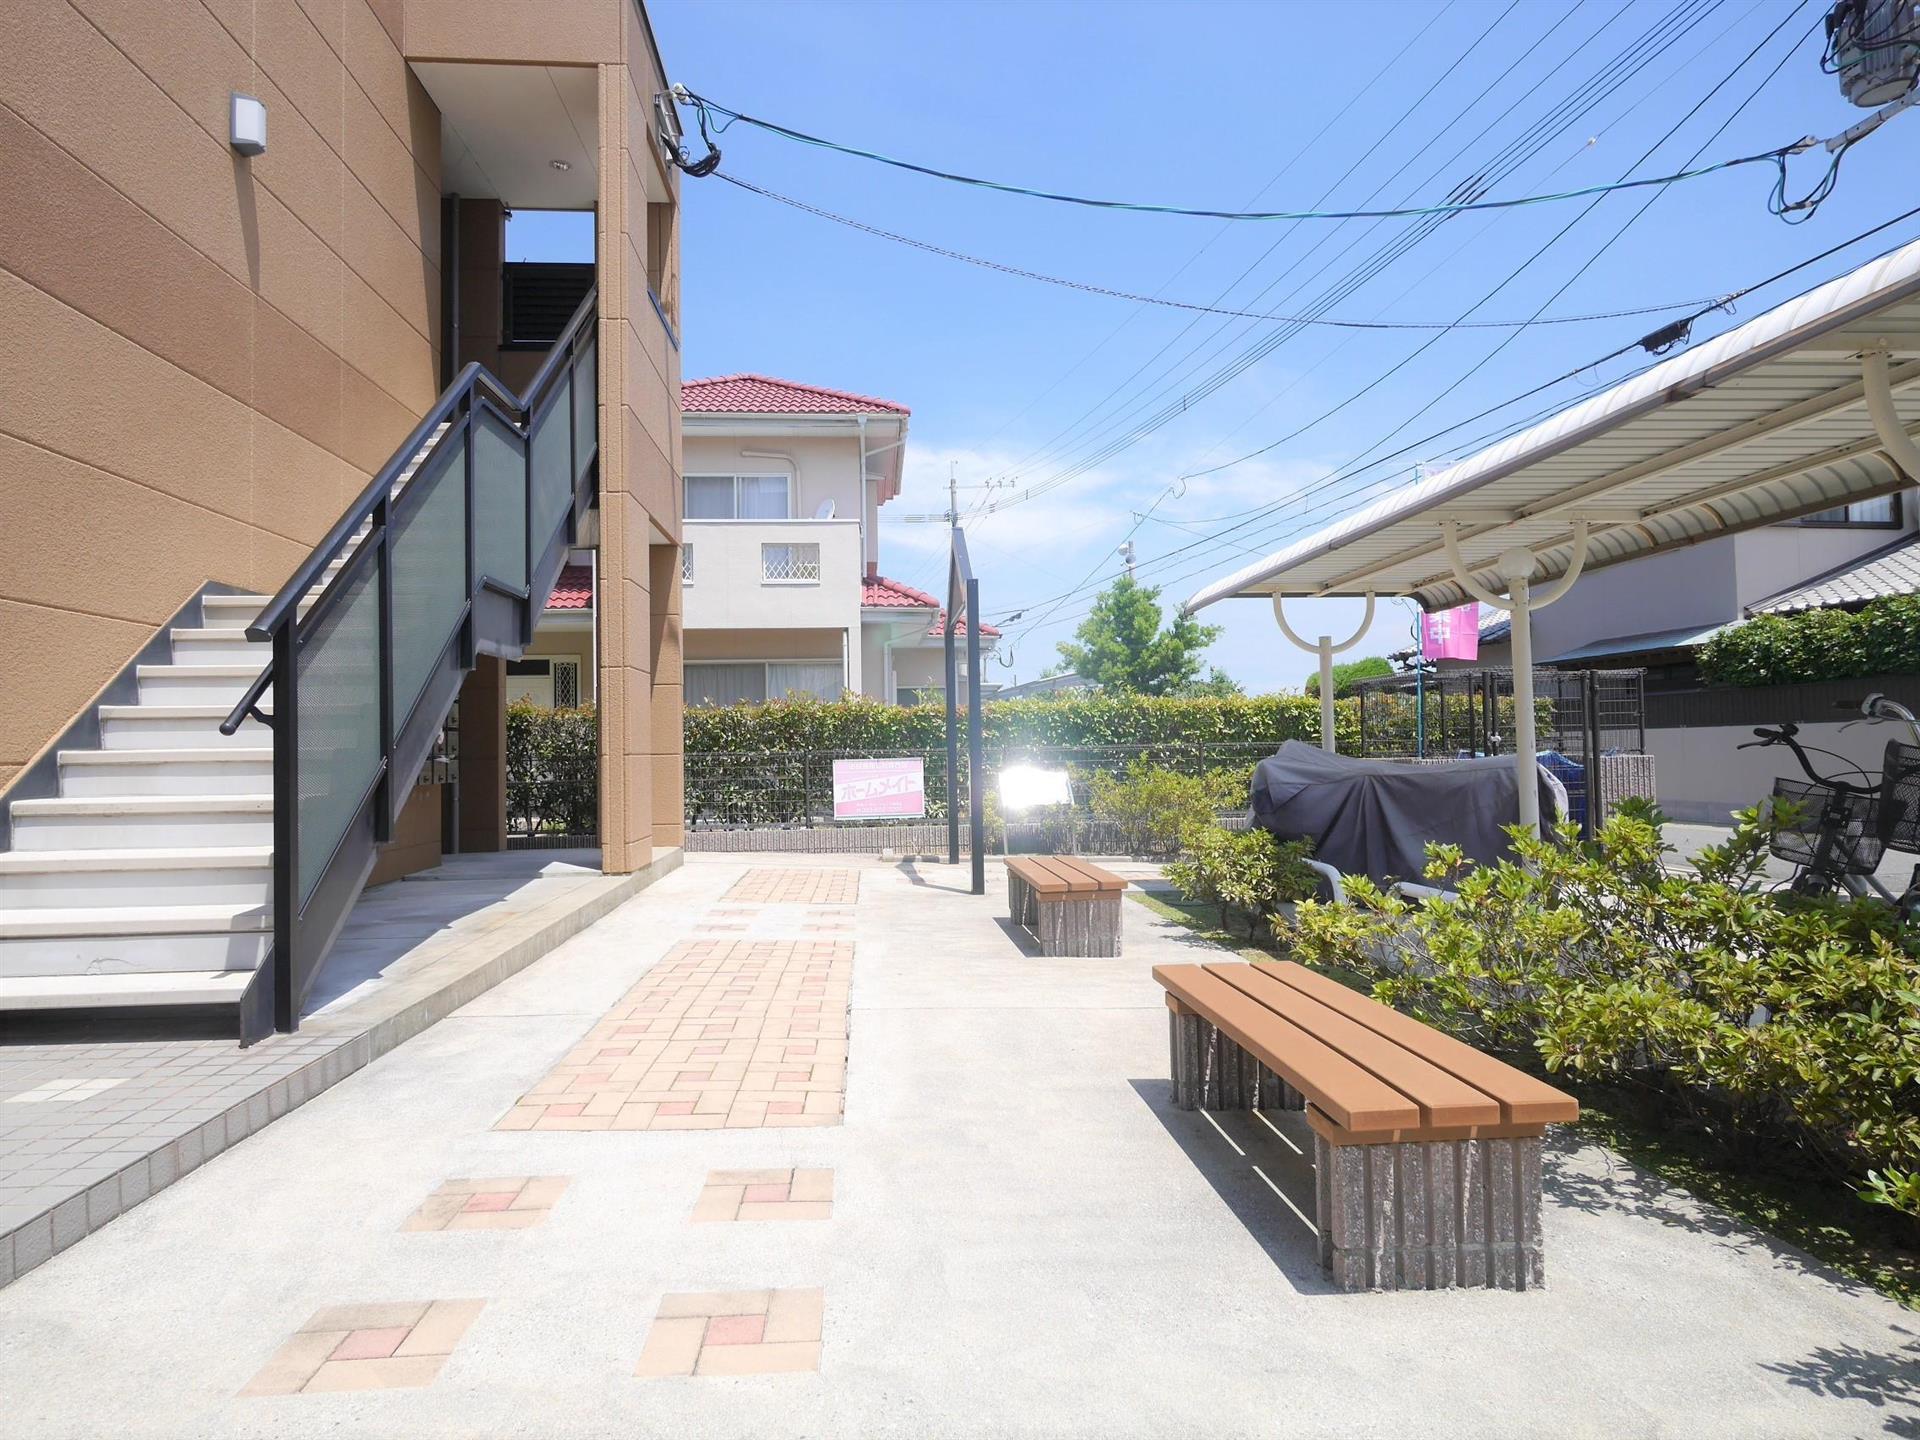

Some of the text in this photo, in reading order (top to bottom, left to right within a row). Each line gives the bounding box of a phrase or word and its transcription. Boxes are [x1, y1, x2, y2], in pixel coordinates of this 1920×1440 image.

[841, 775, 916, 801] ホームメイト
